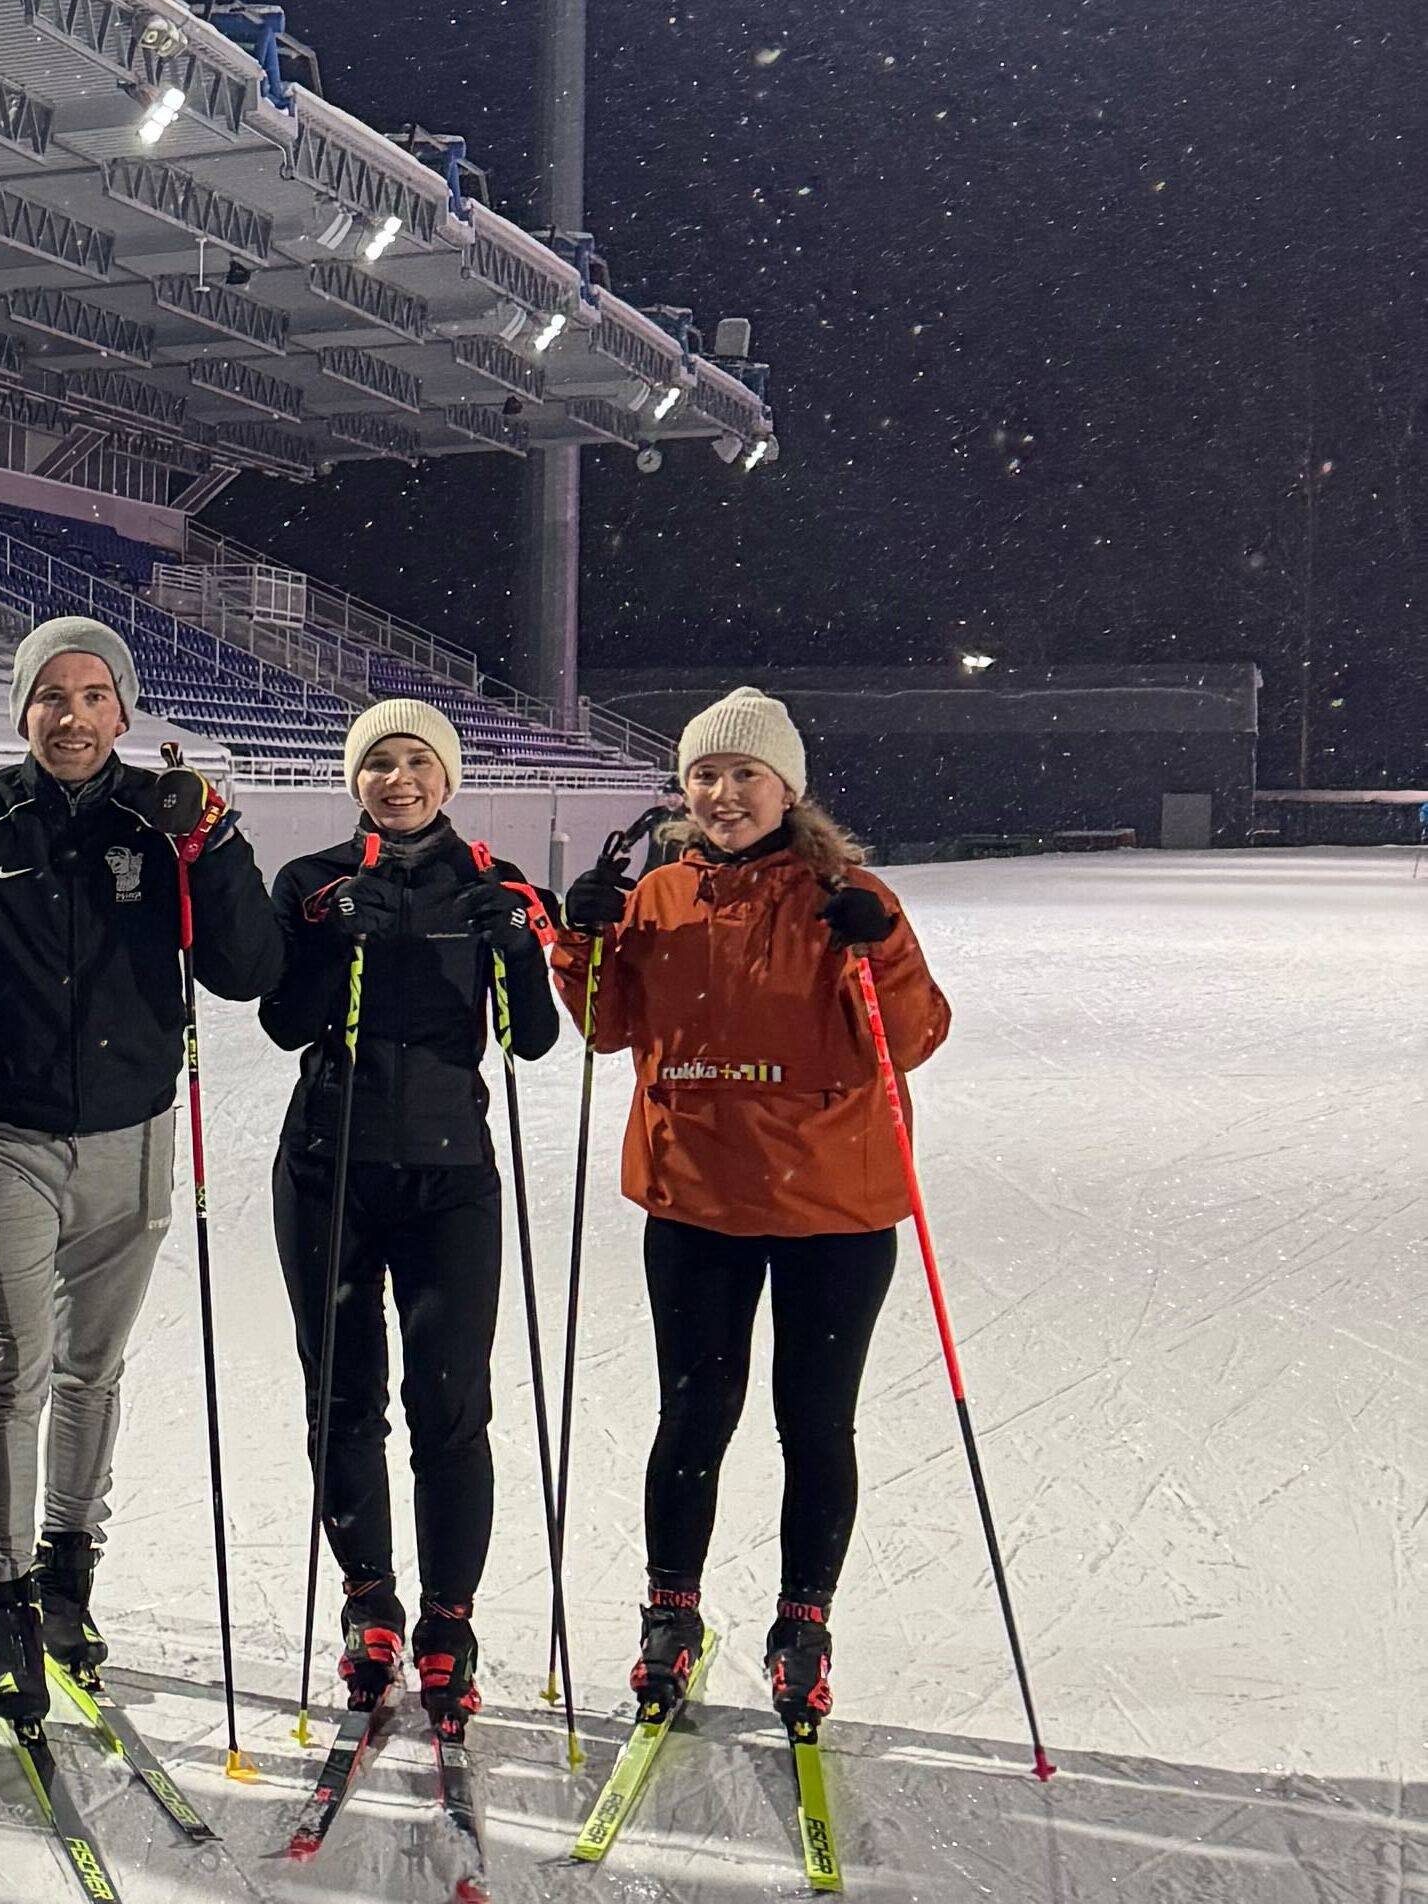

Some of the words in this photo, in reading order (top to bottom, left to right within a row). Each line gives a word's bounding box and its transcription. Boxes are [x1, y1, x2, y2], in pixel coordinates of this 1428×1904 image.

[662, 1062, 718, 1080] rukka
[65, 1836, 115, 1901] FISCHER
[805, 1816, 834, 1875] FISCHER
